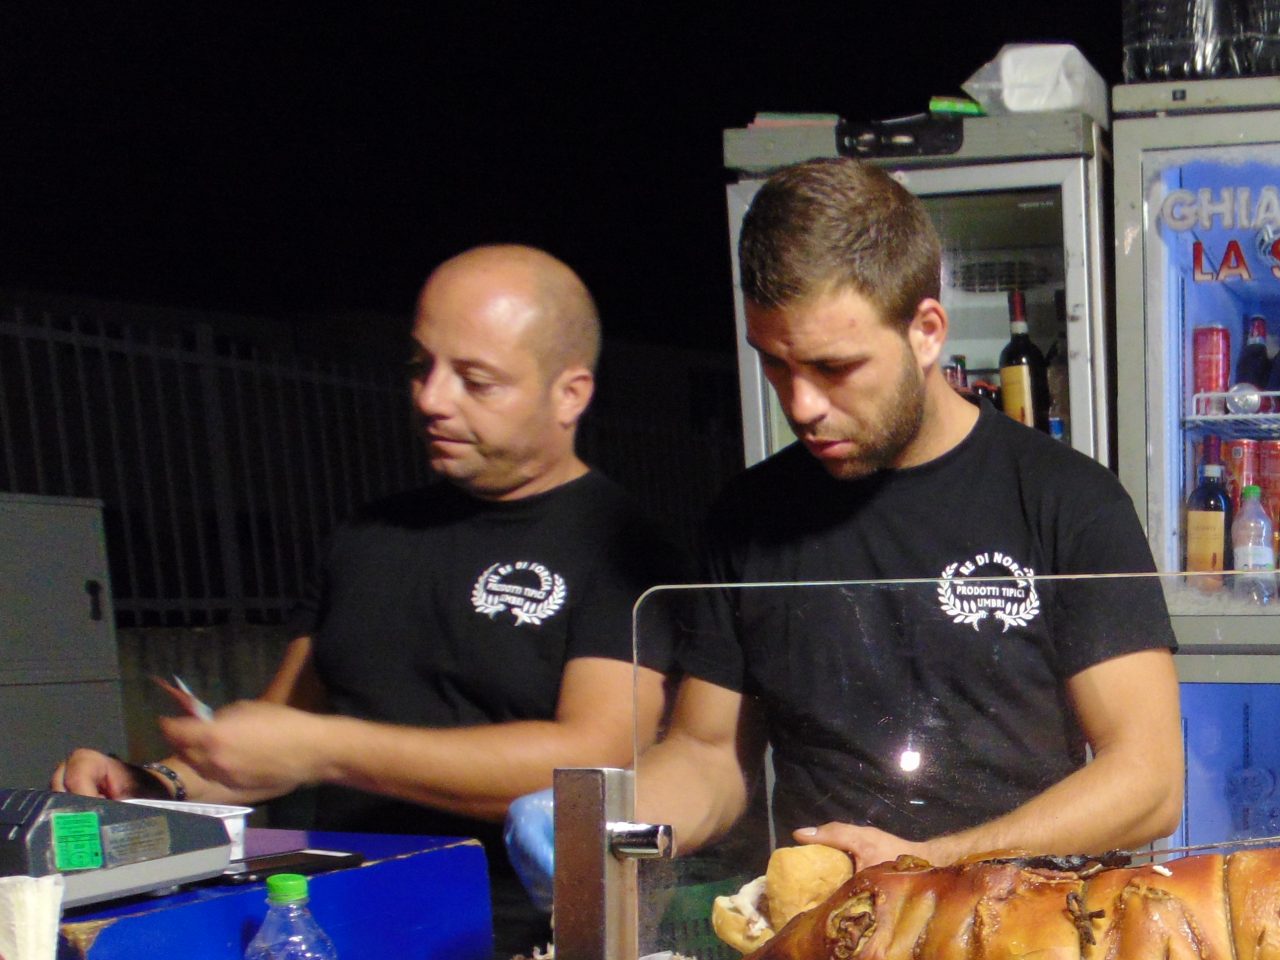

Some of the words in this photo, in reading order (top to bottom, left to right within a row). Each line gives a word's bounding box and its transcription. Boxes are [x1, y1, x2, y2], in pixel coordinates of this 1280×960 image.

[1192, 240, 1252, 282] LA
[975, 552, 990, 566] DI
[993, 552, 1028, 588] NORCA
[956, 585, 1000, 596] PRODOTTI
[1001, 587, 1025, 598] TIPICI
[977, 598, 1005, 608] UMBRI
